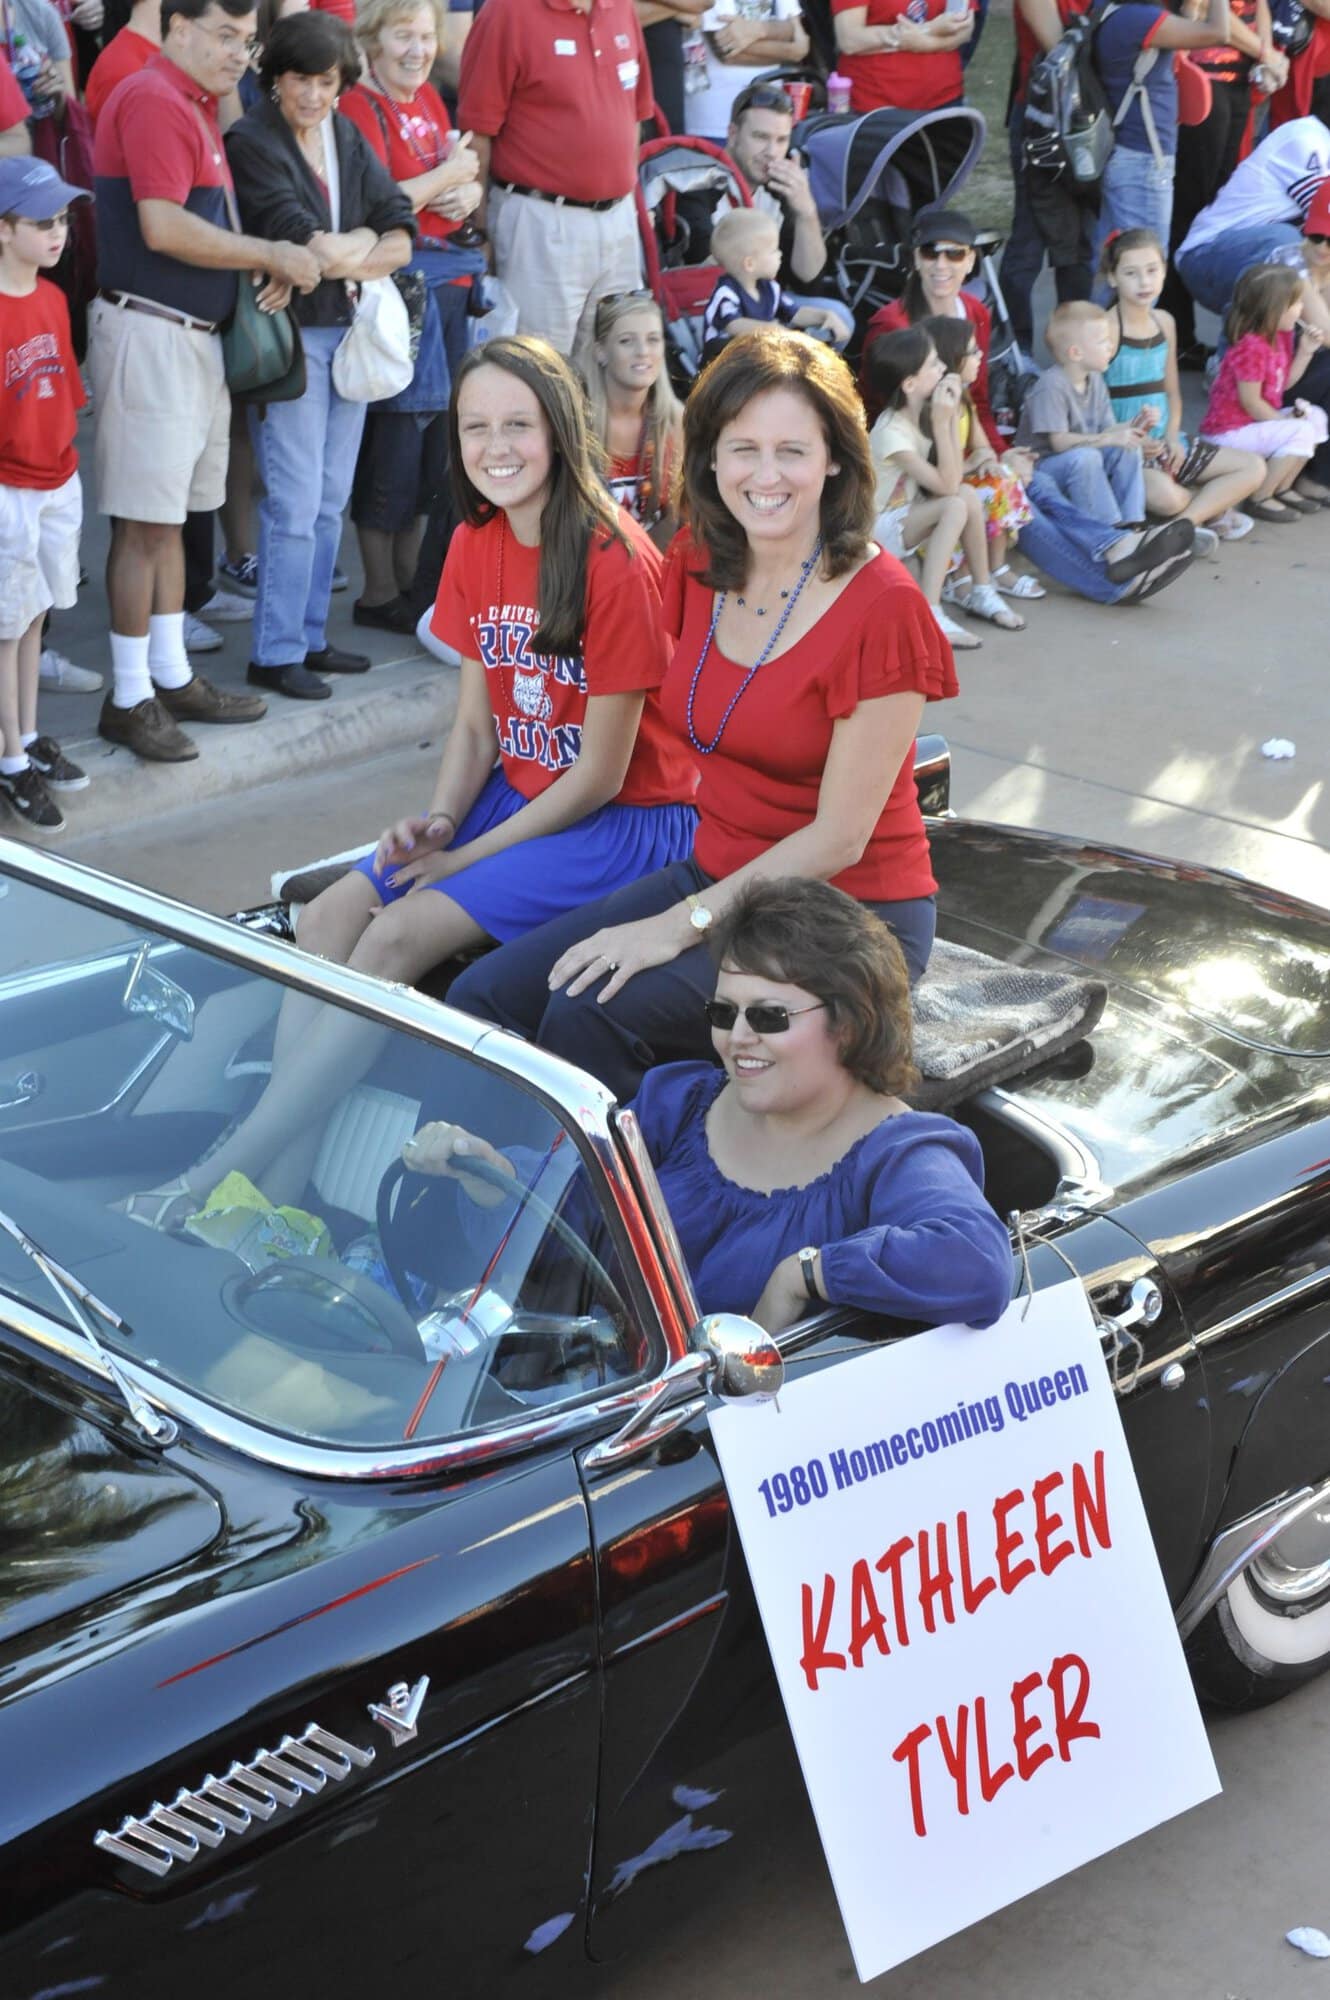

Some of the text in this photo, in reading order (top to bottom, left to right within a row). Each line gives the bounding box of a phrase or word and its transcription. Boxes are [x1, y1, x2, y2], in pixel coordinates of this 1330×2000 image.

[475, 620, 588, 693] RIZON
[488, 604, 541, 625] UNIVER
[757, 1363, 1088, 1518] 1980 Homecoming Queen
[799, 1450, 1113, 1691] KATHLEEN
[892, 1653, 1101, 1837] TYLER
